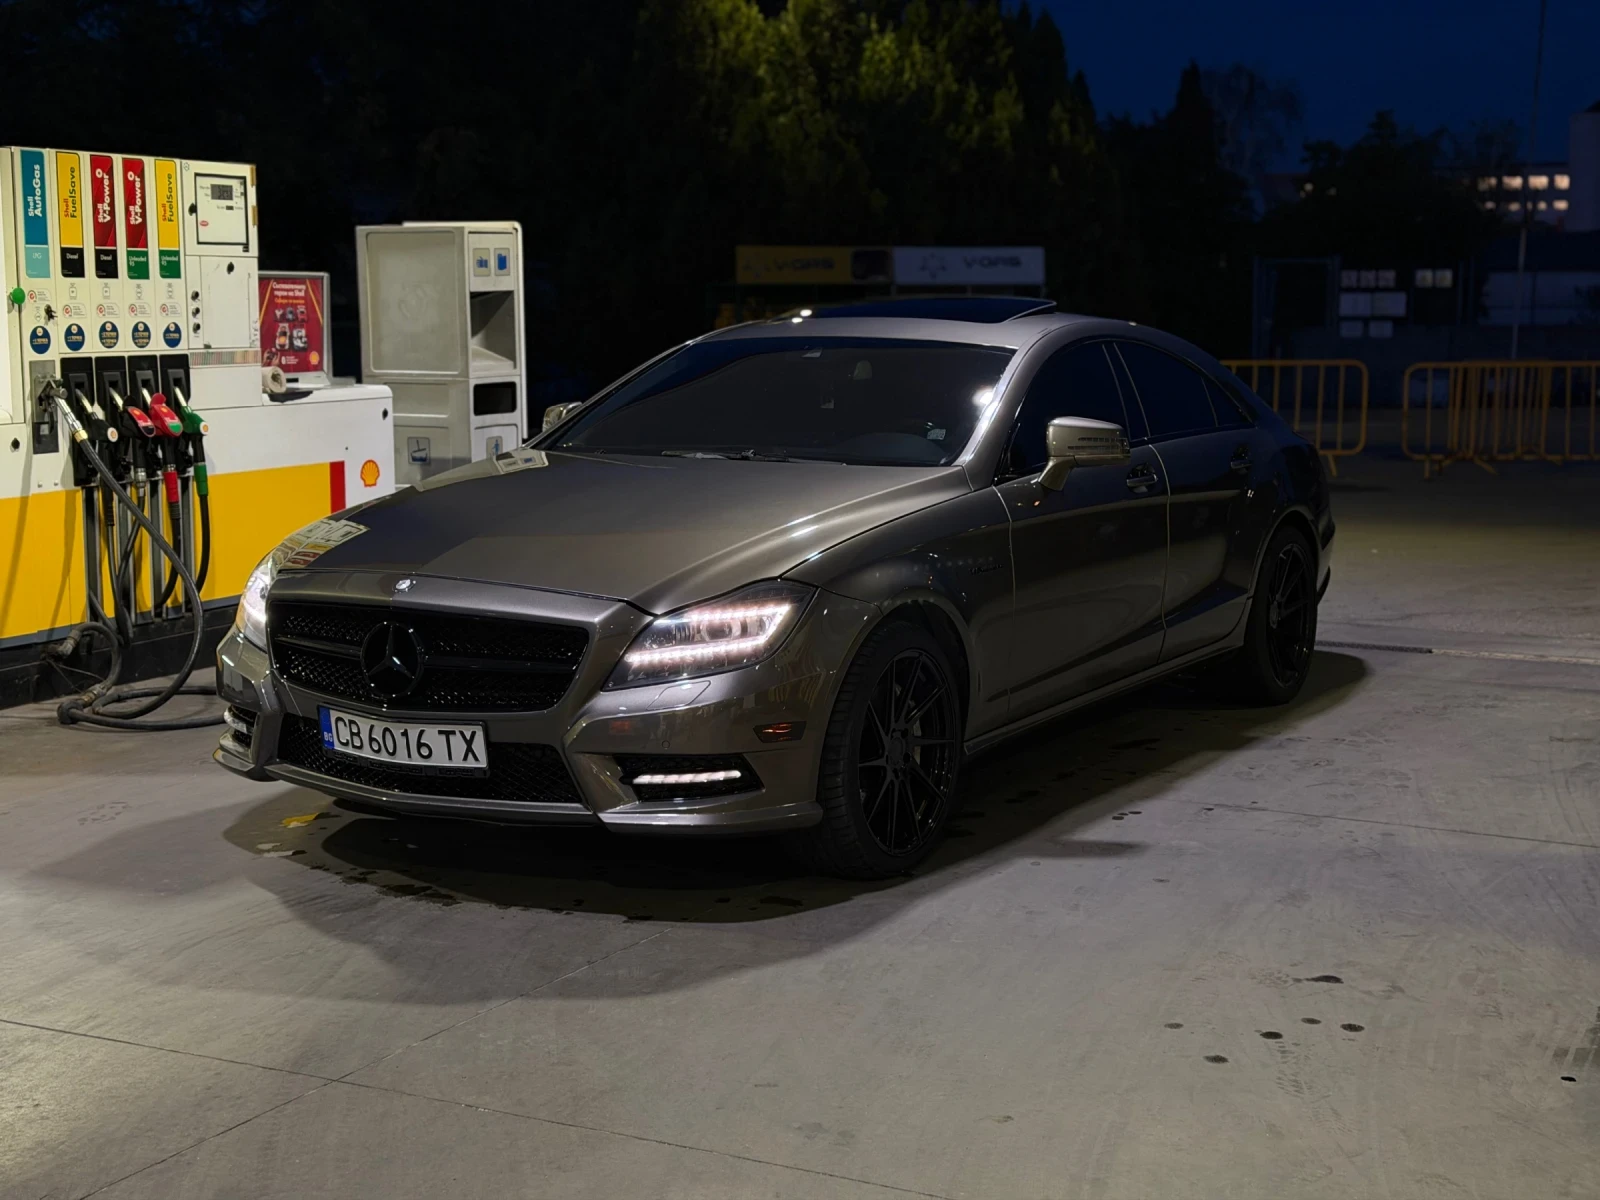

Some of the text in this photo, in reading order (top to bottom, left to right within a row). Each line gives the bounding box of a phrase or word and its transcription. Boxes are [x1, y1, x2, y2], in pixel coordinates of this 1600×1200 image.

[34, 164, 43, 217] AutoGas
[70, 166, 78, 219] FuelSave
[102, 173, 110, 223] V-Power
[134, 176, 142, 225] V-Power
[167, 173, 175, 222] FuelSave
[66, 252, 79, 260] Diesel
[100, 253, 112, 261] Diesel
[324, 731, 333, 743] BG
[334, 716, 481, 762] CB 6016 TX
